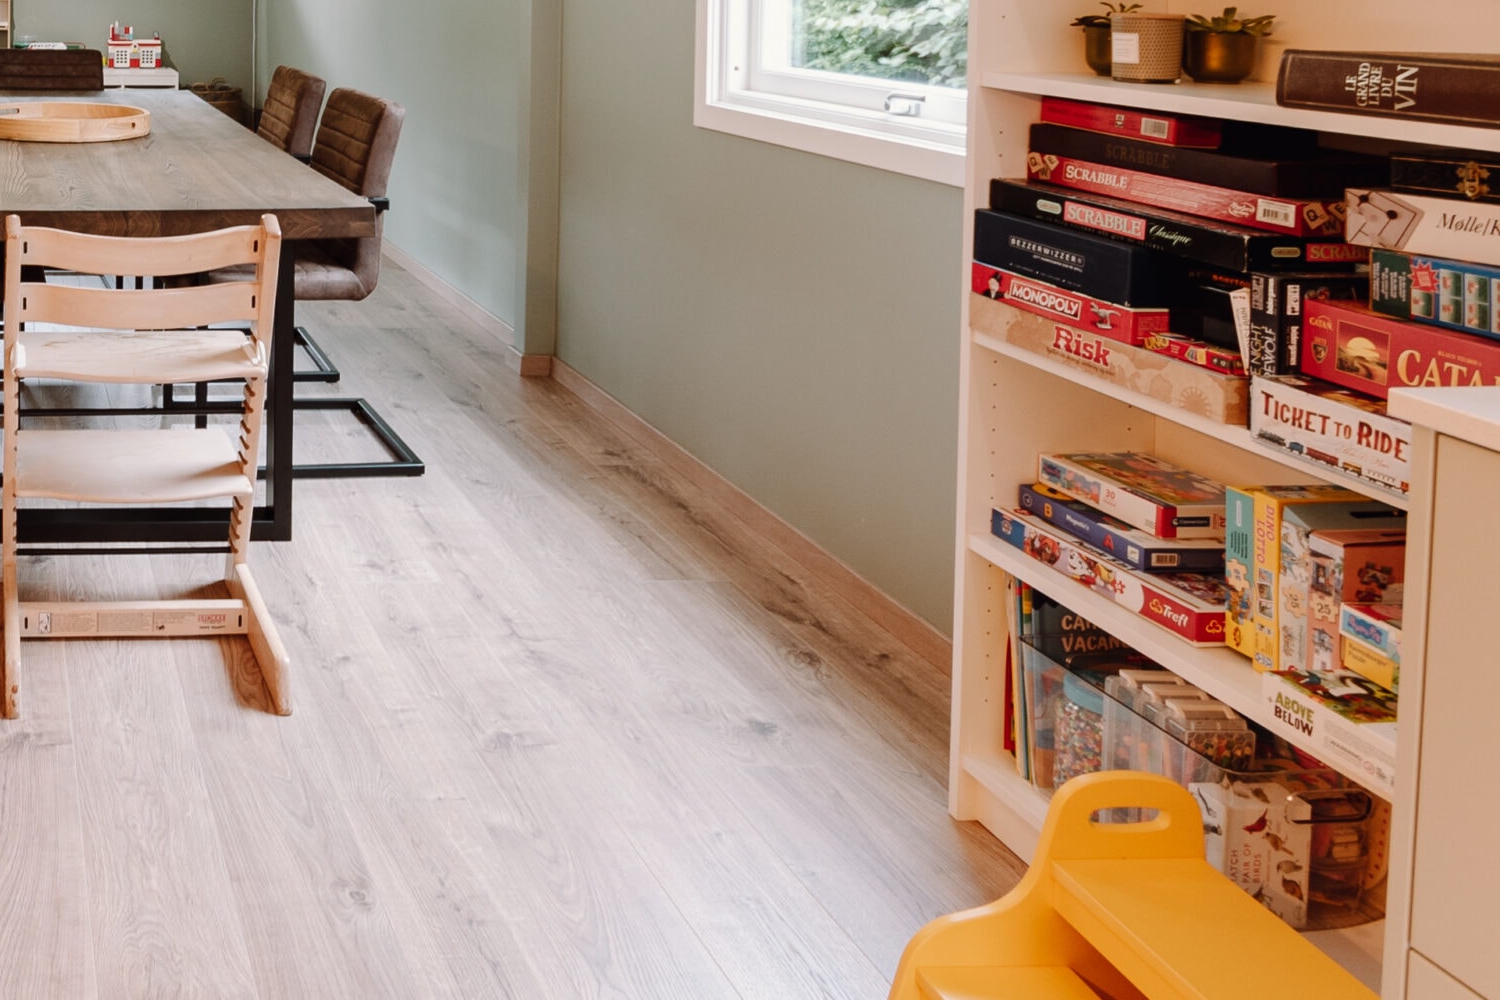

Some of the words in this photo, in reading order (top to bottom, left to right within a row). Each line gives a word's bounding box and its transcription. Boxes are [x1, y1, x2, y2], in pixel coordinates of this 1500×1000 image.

[1344, 75, 1357, 91] LE
[1356, 62, 1371, 106] GRAND
[1368, 66, 1383, 105] LIVRE
[1381, 77, 1393, 97] DU
[1394, 64, 1419, 110] VIN
[1065, 164, 1128, 189] SCRABBLE
[1067, 205, 1142, 238] SCRABBLE
[1148, 222, 1194, 248] Classique
[1010, 237, 1077, 264] BEZZERWIZZER
[1310, 245, 1367, 260] SCRAB
[1012, 284, 1080, 316] MONOPOLY
[1053, 326, 1110, 368] Risk
[1144, 336, 1169, 350] UNO
[1251, 323, 1262, 364] NIGHT
[1264, 327, 1276, 377] REWOLF
[1397, 349, 1500, 387] CAT
[1260, 390, 1330, 436] TICKET
[1334, 421, 1352, 440] TO
[1356, 420, 1410, 464] RIDE
[1105, 488, 1116, 500] 30
[1044, 504, 1053, 518] B
[1267, 504, 1275, 542] DINO
[1103, 536, 1114, 550] A
[1256, 519, 1266, 563] LOTTO
[1162, 604, 1189, 626] Trefl
[1317, 602, 1331, 615] 25
[1274, 704, 1314, 738] BELOW
[1275, 690, 1315, 724] ABOVE
[1243, 843, 1252, 857] OF
[1242, 859, 1250, 884] PAIR
[1253, 853, 1261, 884] BIRDS
